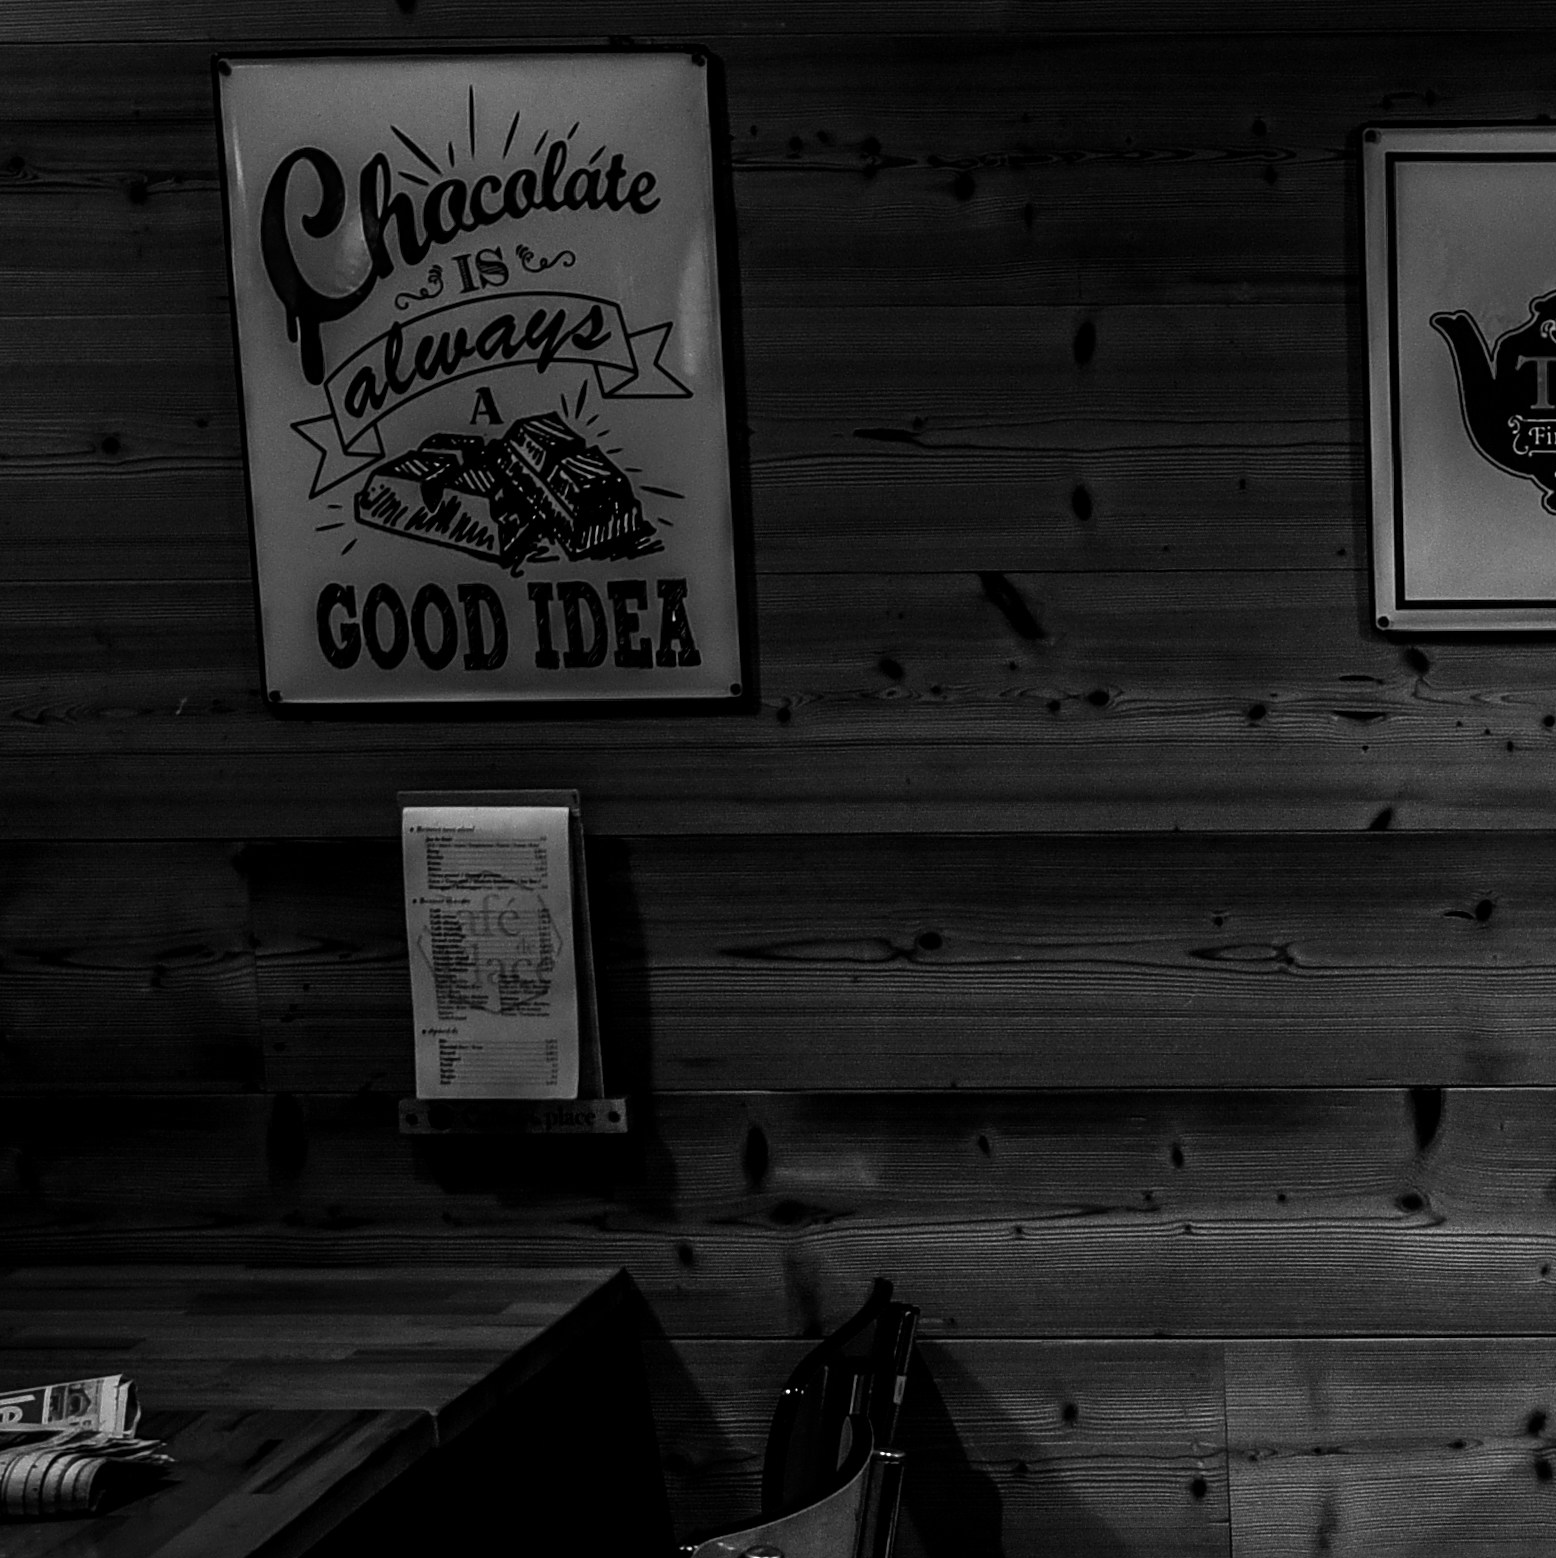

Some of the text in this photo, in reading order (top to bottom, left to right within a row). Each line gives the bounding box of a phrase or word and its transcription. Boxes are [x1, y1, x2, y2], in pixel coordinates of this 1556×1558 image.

[259, 140, 662, 386] Chocolate
[451, 246, 511, 294] IS
[343, 303, 612, 419] always
[468, 386, 504, 425] A
[315, 577, 702, 672] GOOD IDEA
[543, 1105, 597, 1130] place
